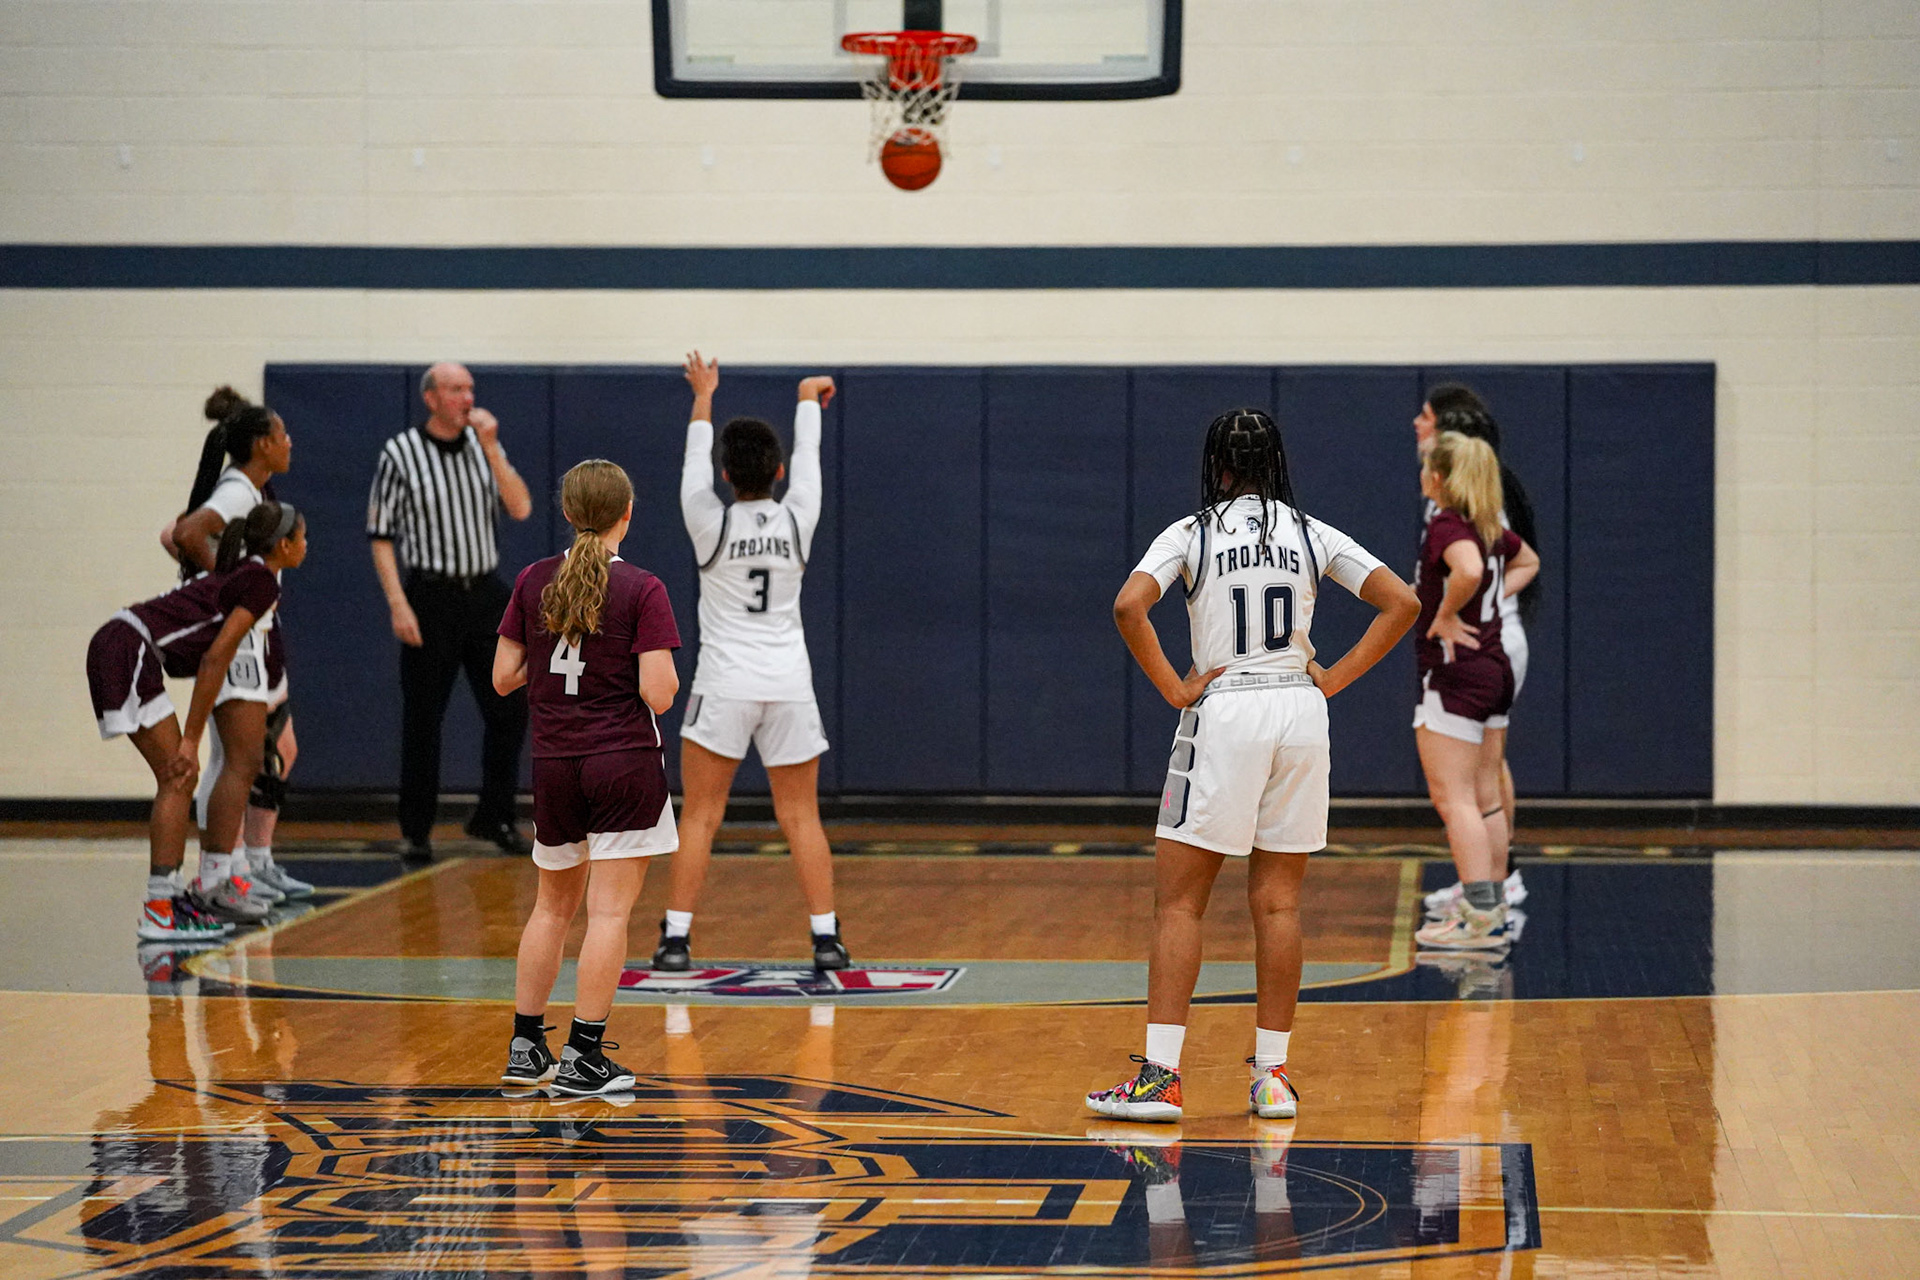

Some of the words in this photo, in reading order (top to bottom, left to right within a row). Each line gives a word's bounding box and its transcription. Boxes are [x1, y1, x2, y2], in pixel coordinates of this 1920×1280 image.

[729, 537, 790, 560] TROJANS
[1216, 545, 1300, 577] TROJANS
[747, 568, 770, 613] 3
[1230, 584, 1296, 657] 10
[549, 633, 586, 696] 4
[1278, 673, 1314, 684] OUR
